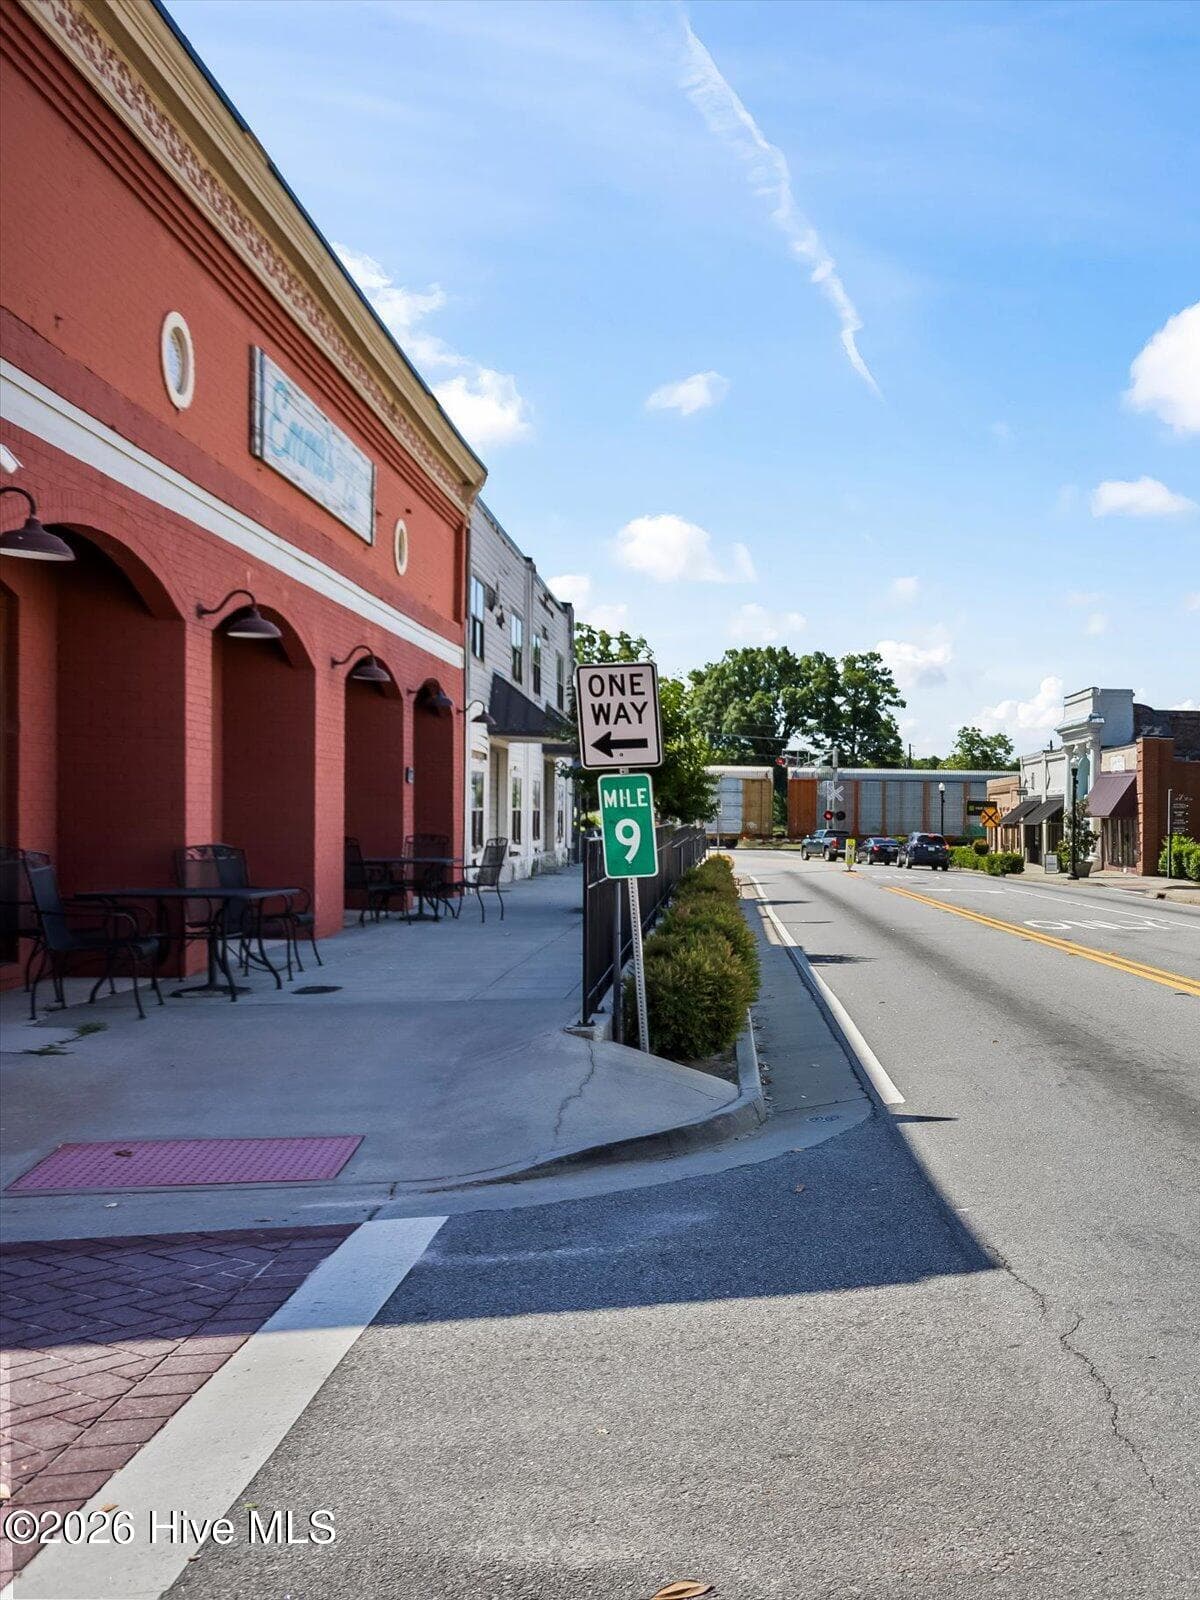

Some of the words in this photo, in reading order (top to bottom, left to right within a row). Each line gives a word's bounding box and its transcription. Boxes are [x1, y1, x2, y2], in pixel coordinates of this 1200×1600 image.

[588, 673, 645, 697] ONE
[591, 701, 648, 726] WAY
[603, 788, 648, 808] MILE
[615, 818, 641, 864] 9
